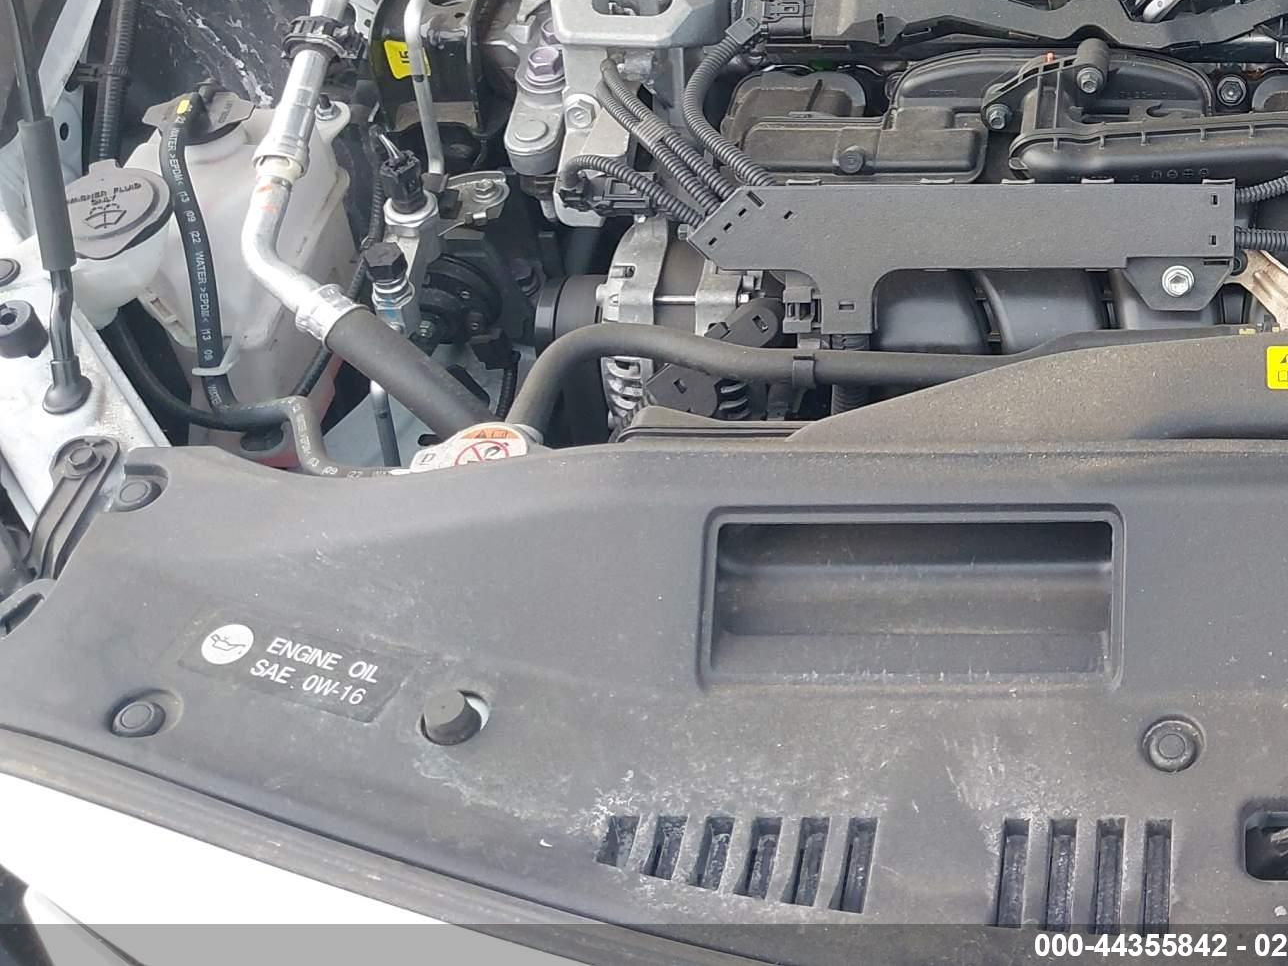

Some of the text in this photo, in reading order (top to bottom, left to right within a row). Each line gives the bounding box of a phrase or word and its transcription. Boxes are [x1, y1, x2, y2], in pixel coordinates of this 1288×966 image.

[195, 250, 208, 284] WATER
[266, 636, 378, 684] ENGINE OIL
[301, 674, 367, 705] 0W-16
